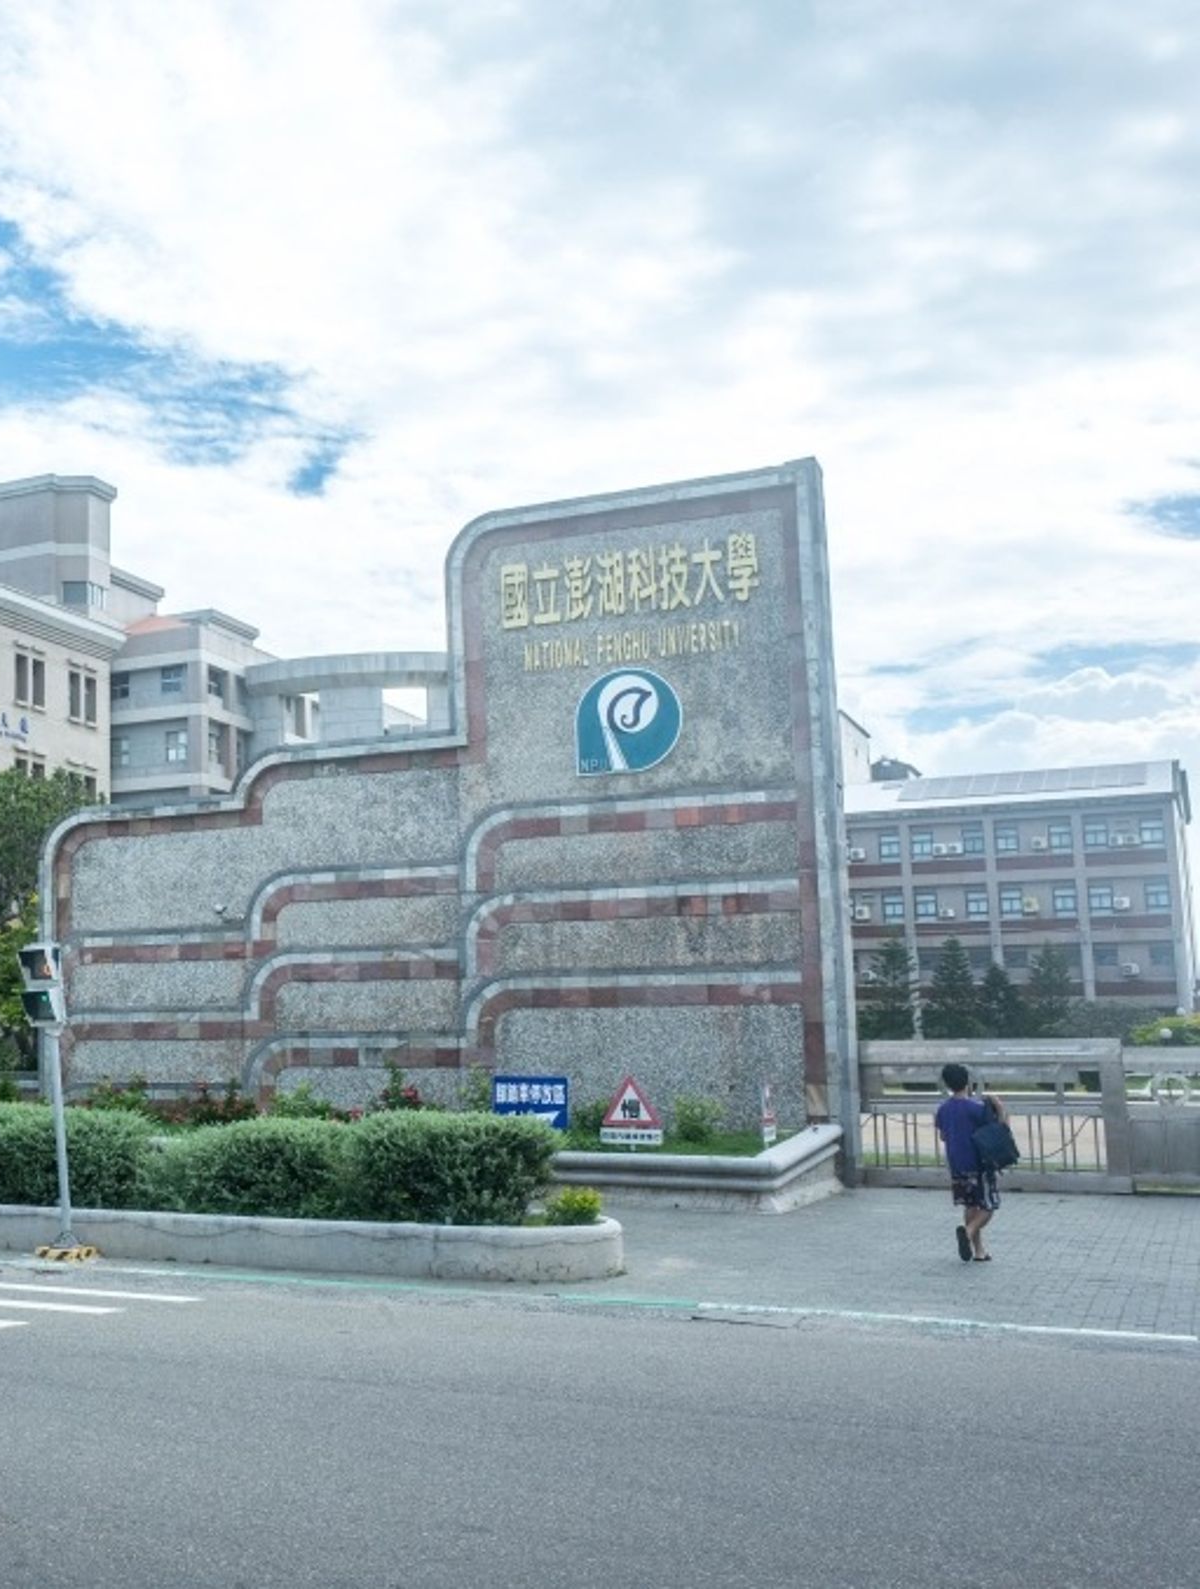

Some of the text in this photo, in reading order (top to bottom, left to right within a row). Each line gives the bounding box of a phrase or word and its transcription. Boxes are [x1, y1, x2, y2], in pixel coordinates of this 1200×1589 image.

[501, 532, 759, 629] 國立澎湖科技大學
[524, 620, 740, 672] NATIONAL PENGHU UNIVERSITY
